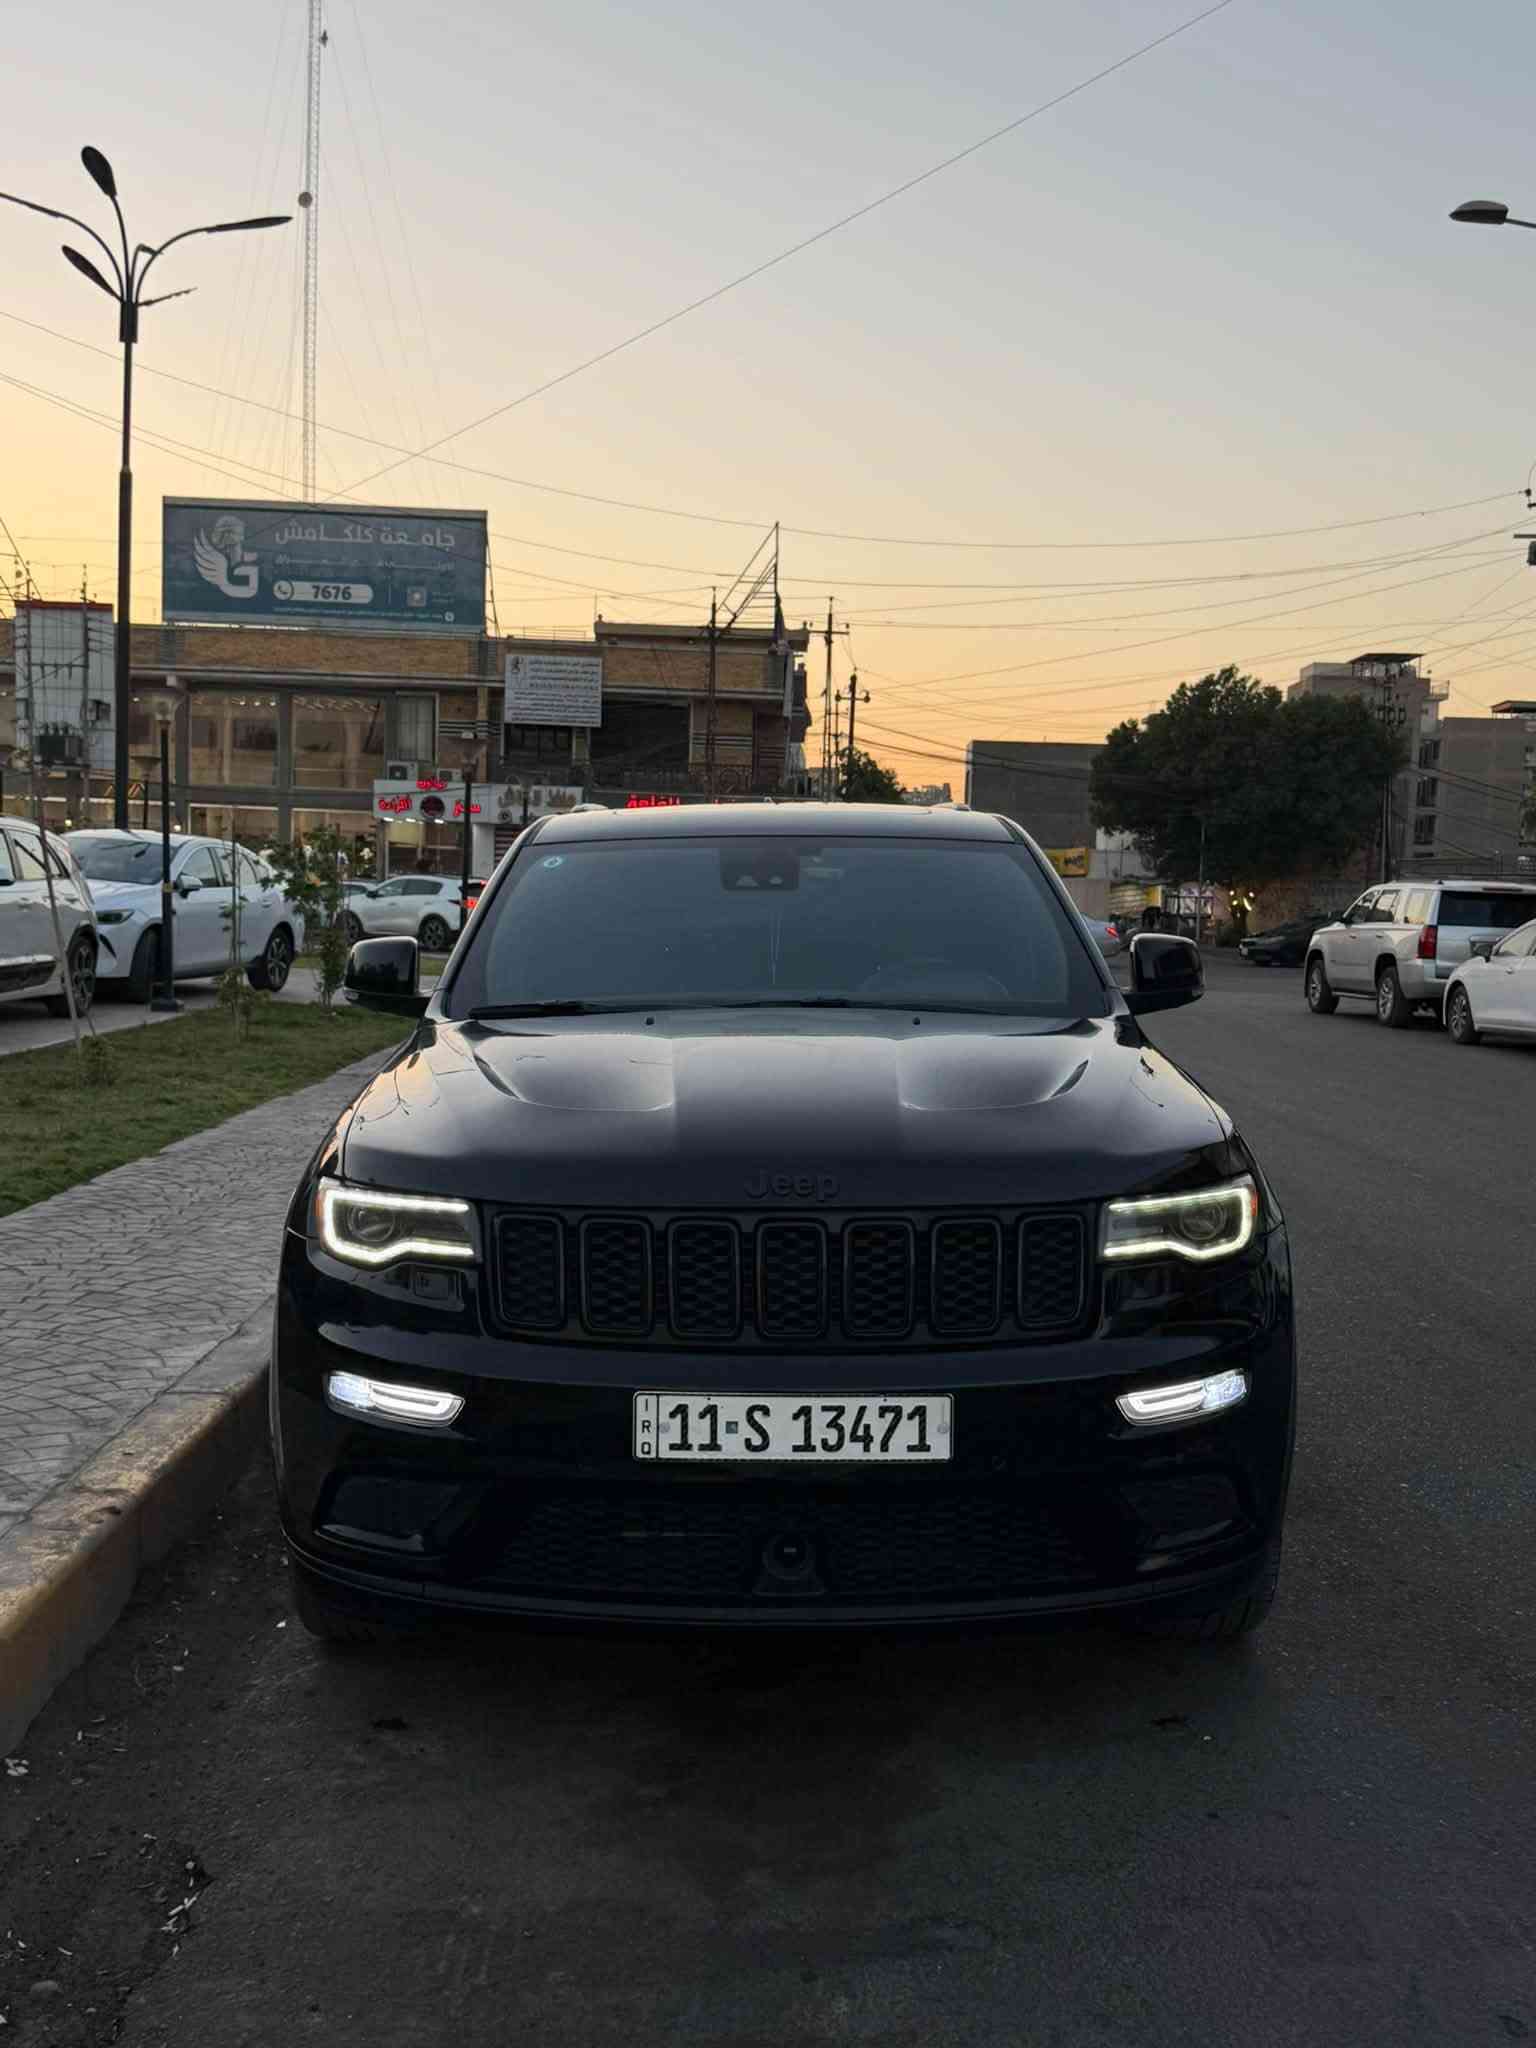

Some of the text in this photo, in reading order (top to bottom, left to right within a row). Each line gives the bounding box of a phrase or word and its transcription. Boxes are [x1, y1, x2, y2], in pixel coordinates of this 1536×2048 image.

[311, 585, 352, 601] 7676
[744, 1169, 841, 1203] Jeep
[668, 1403, 932, 1453] 11 S 13471
